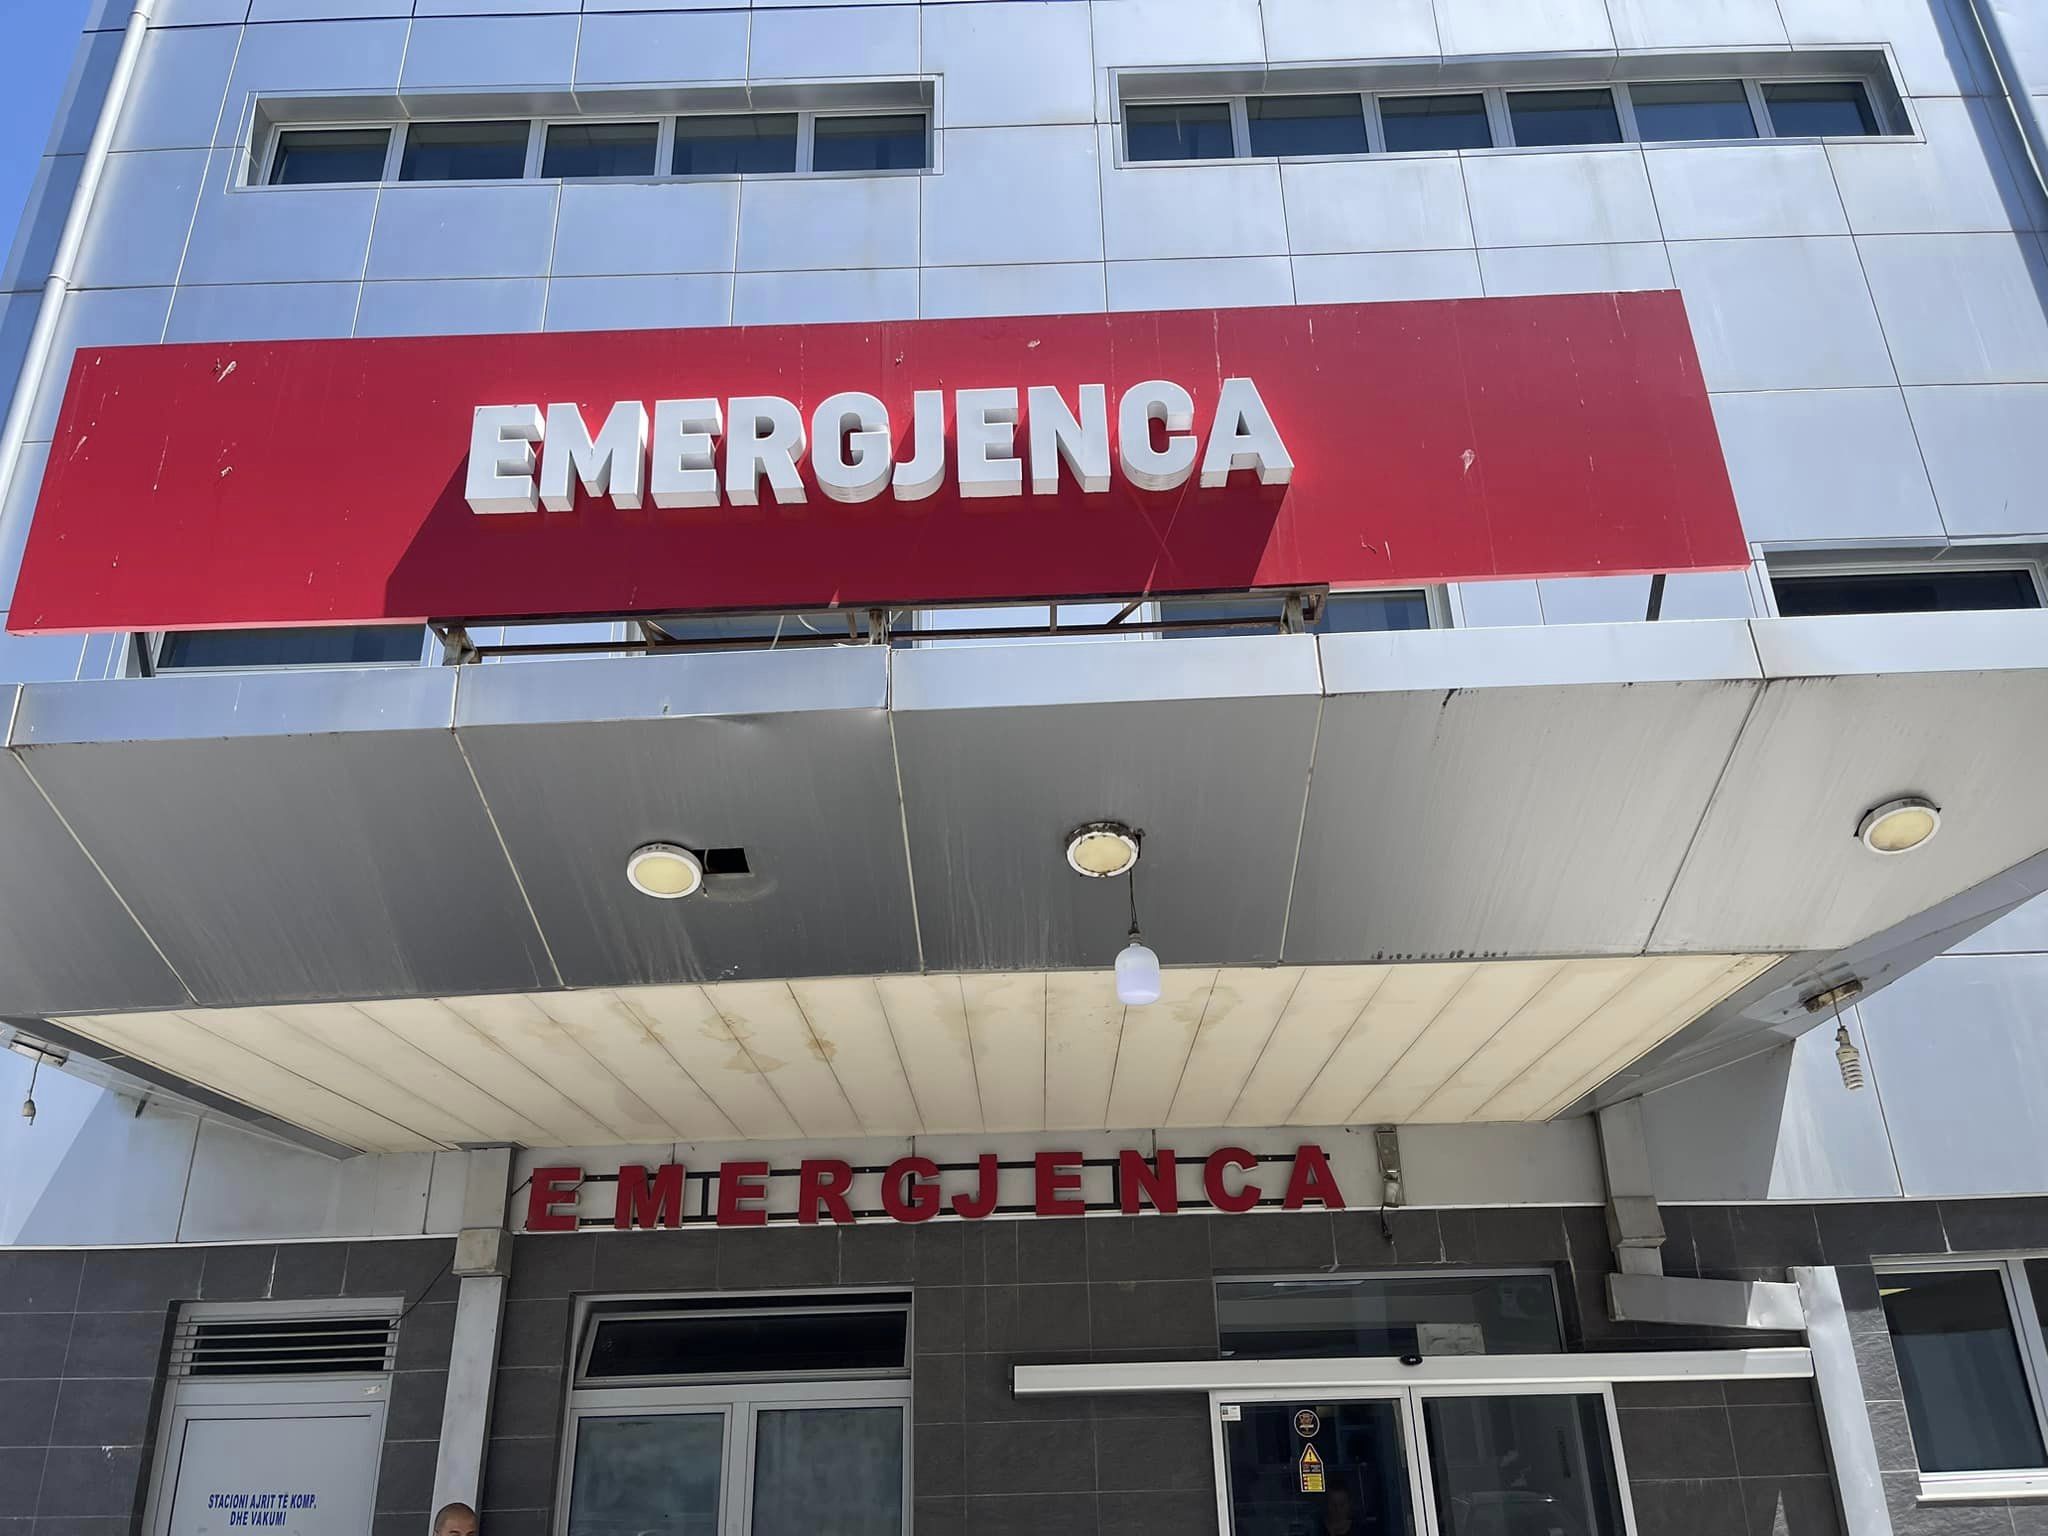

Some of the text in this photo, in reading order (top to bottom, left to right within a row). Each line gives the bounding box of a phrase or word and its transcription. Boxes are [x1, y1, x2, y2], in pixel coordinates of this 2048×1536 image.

[464, 377, 1294, 514] EMERGJENCA
[526, 1144, 1345, 1232] EMERGJENCA
[208, 1494, 248, 1508] STACIONI
[250, 1494, 276, 1508] AJRIT
[290, 1494, 316, 1508] KOMP.
[230, 1511, 286, 1525] DHE VAKUMI
